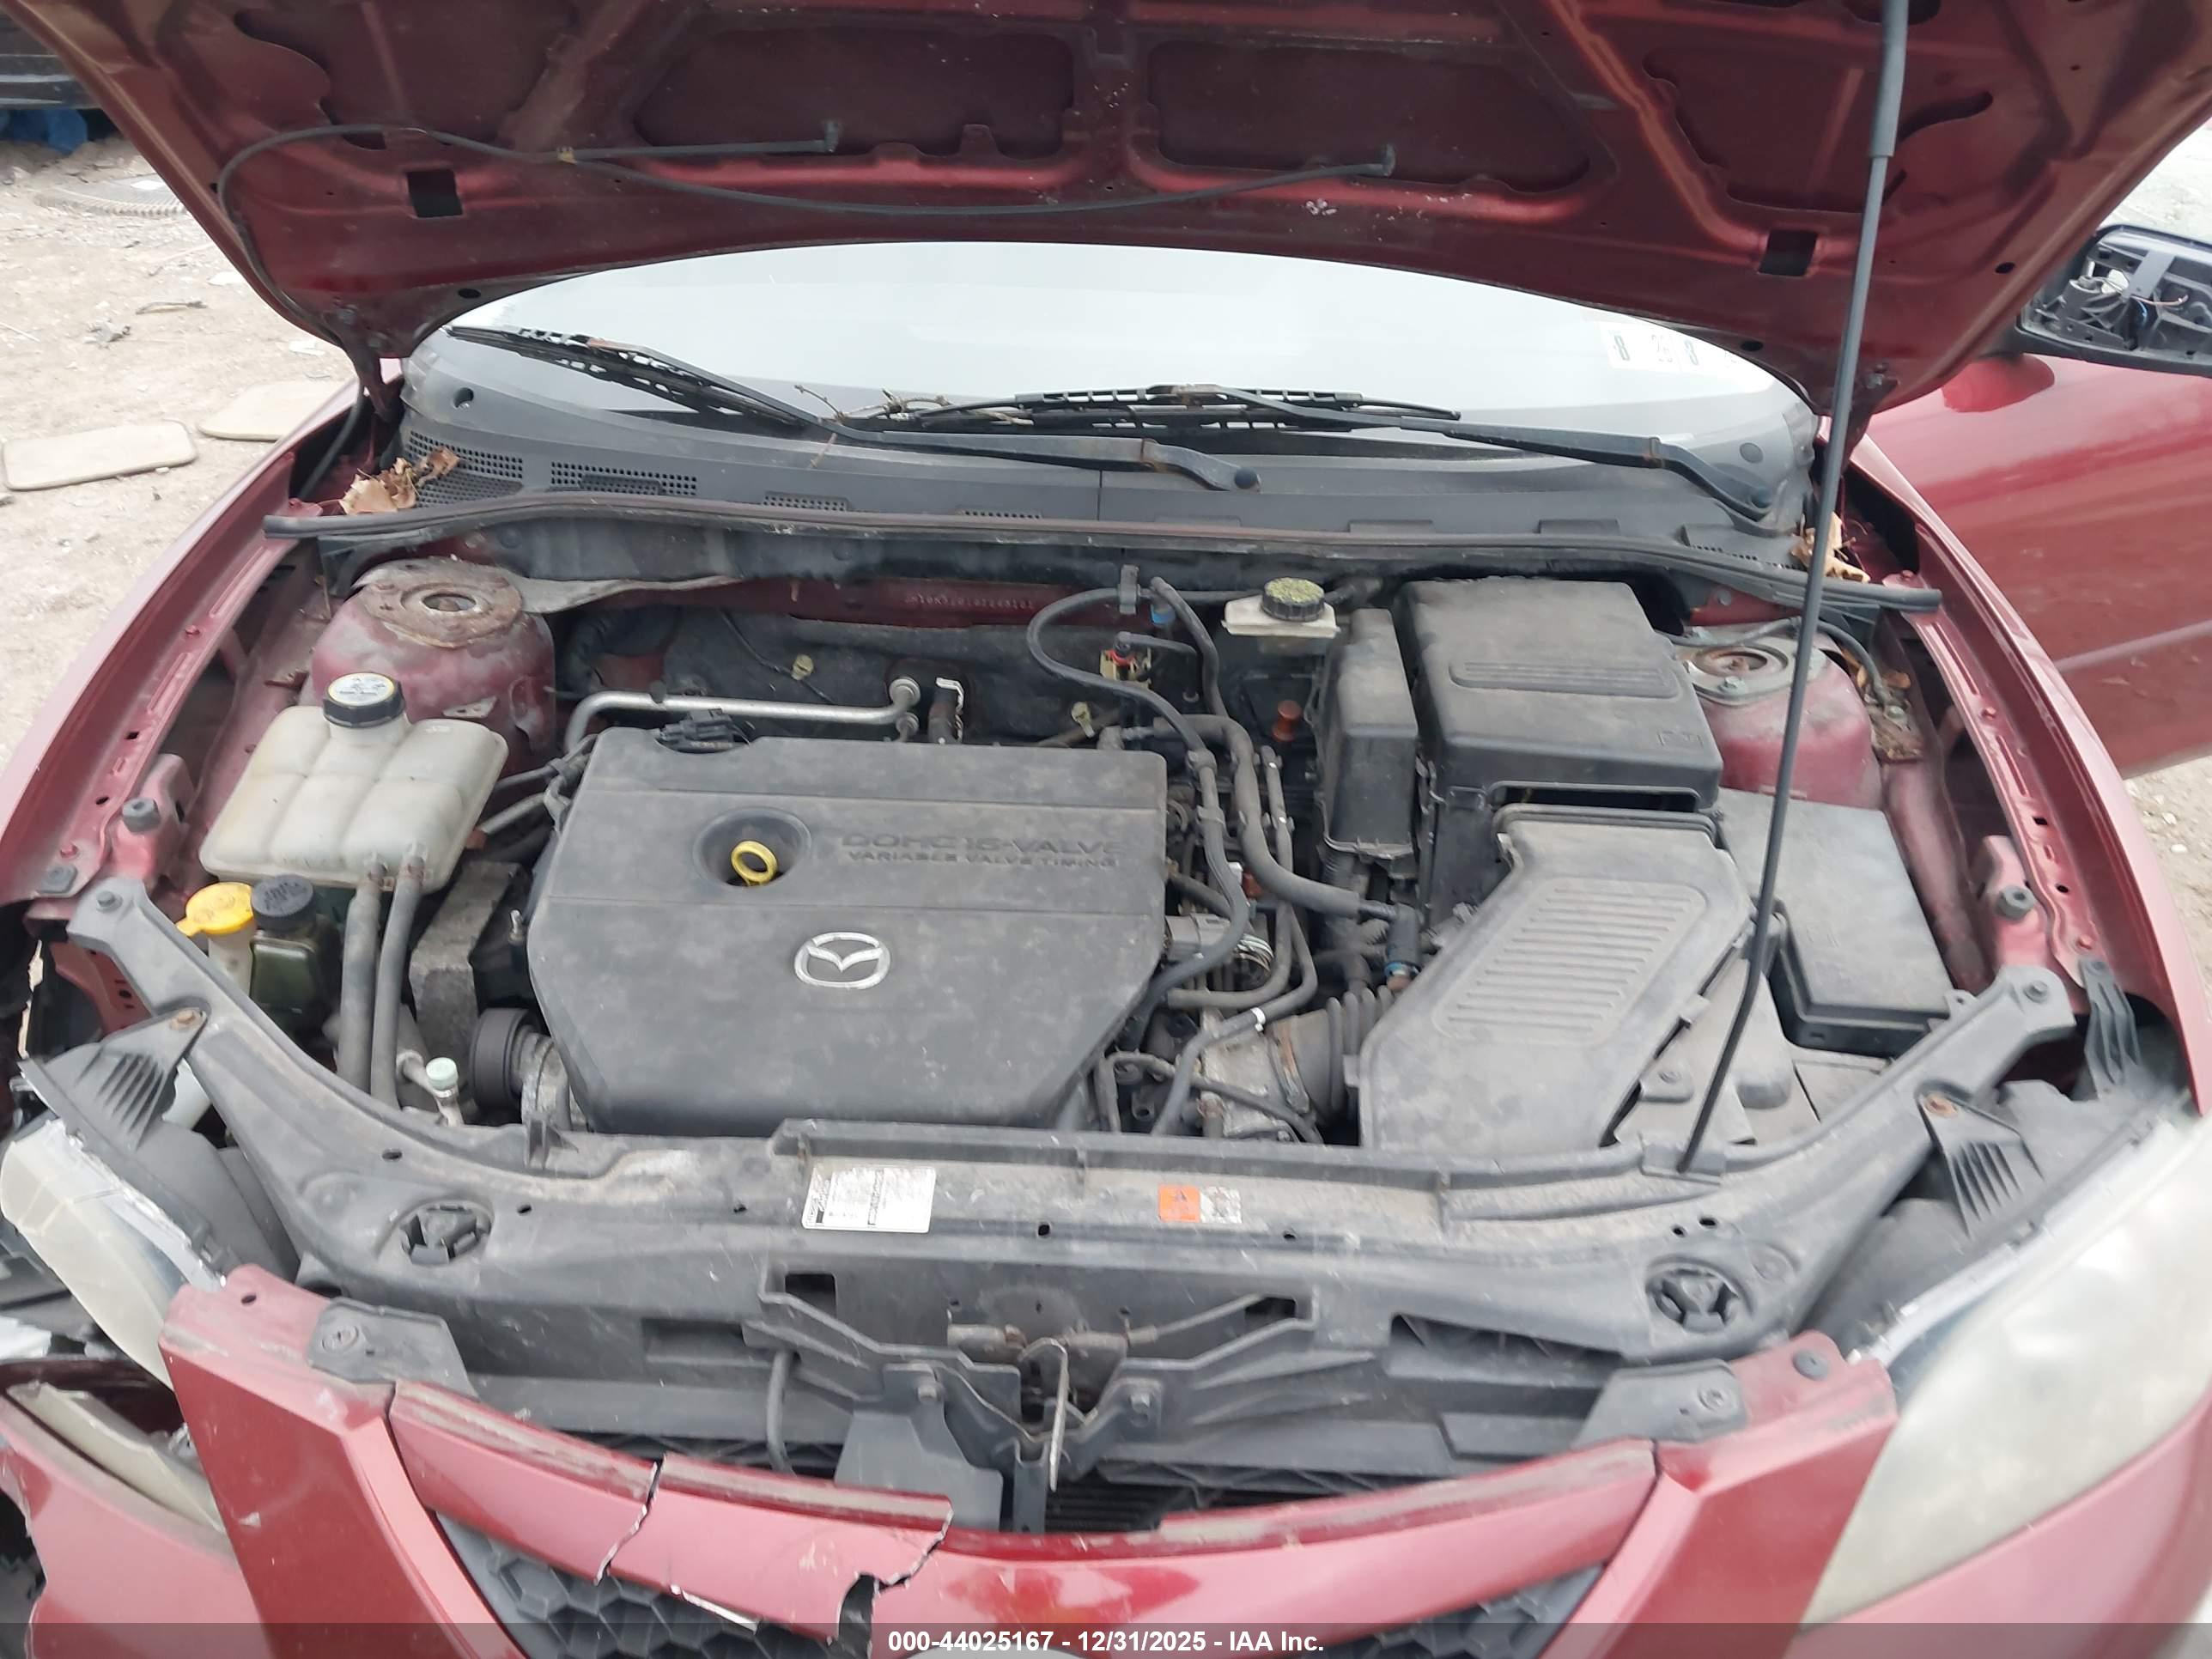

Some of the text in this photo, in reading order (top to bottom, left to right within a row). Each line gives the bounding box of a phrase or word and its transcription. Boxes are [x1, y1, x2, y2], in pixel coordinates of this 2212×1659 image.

[842, 833, 1124, 854] DOHC 16-VALVE
[848, 851, 1119, 868] VARIABLE VALVE TIMING
